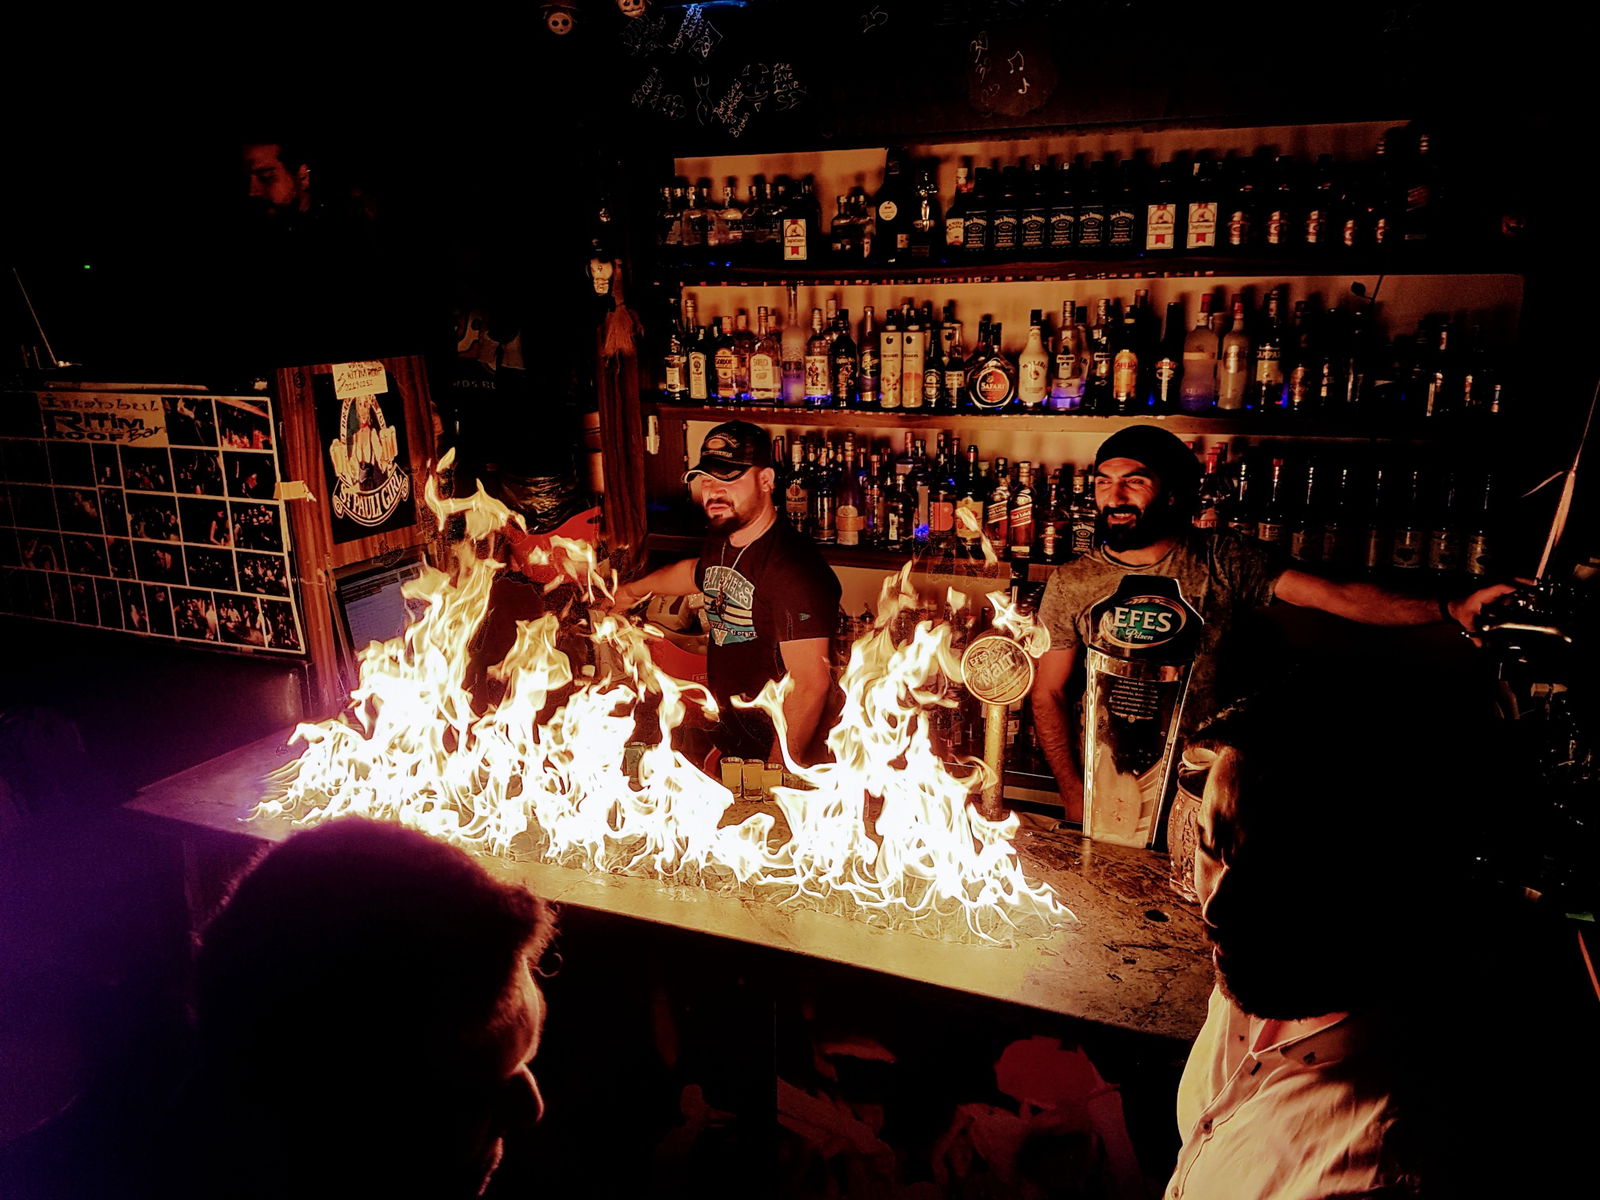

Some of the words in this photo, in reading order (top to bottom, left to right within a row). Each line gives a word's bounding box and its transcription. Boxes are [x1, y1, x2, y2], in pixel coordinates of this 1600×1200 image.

[352, 493, 383, 519] PAULI
[381, 470, 403, 510] GIRL
[1113, 606, 1173, 633] EFES
[1125, 628, 1154, 640] Pilsen
